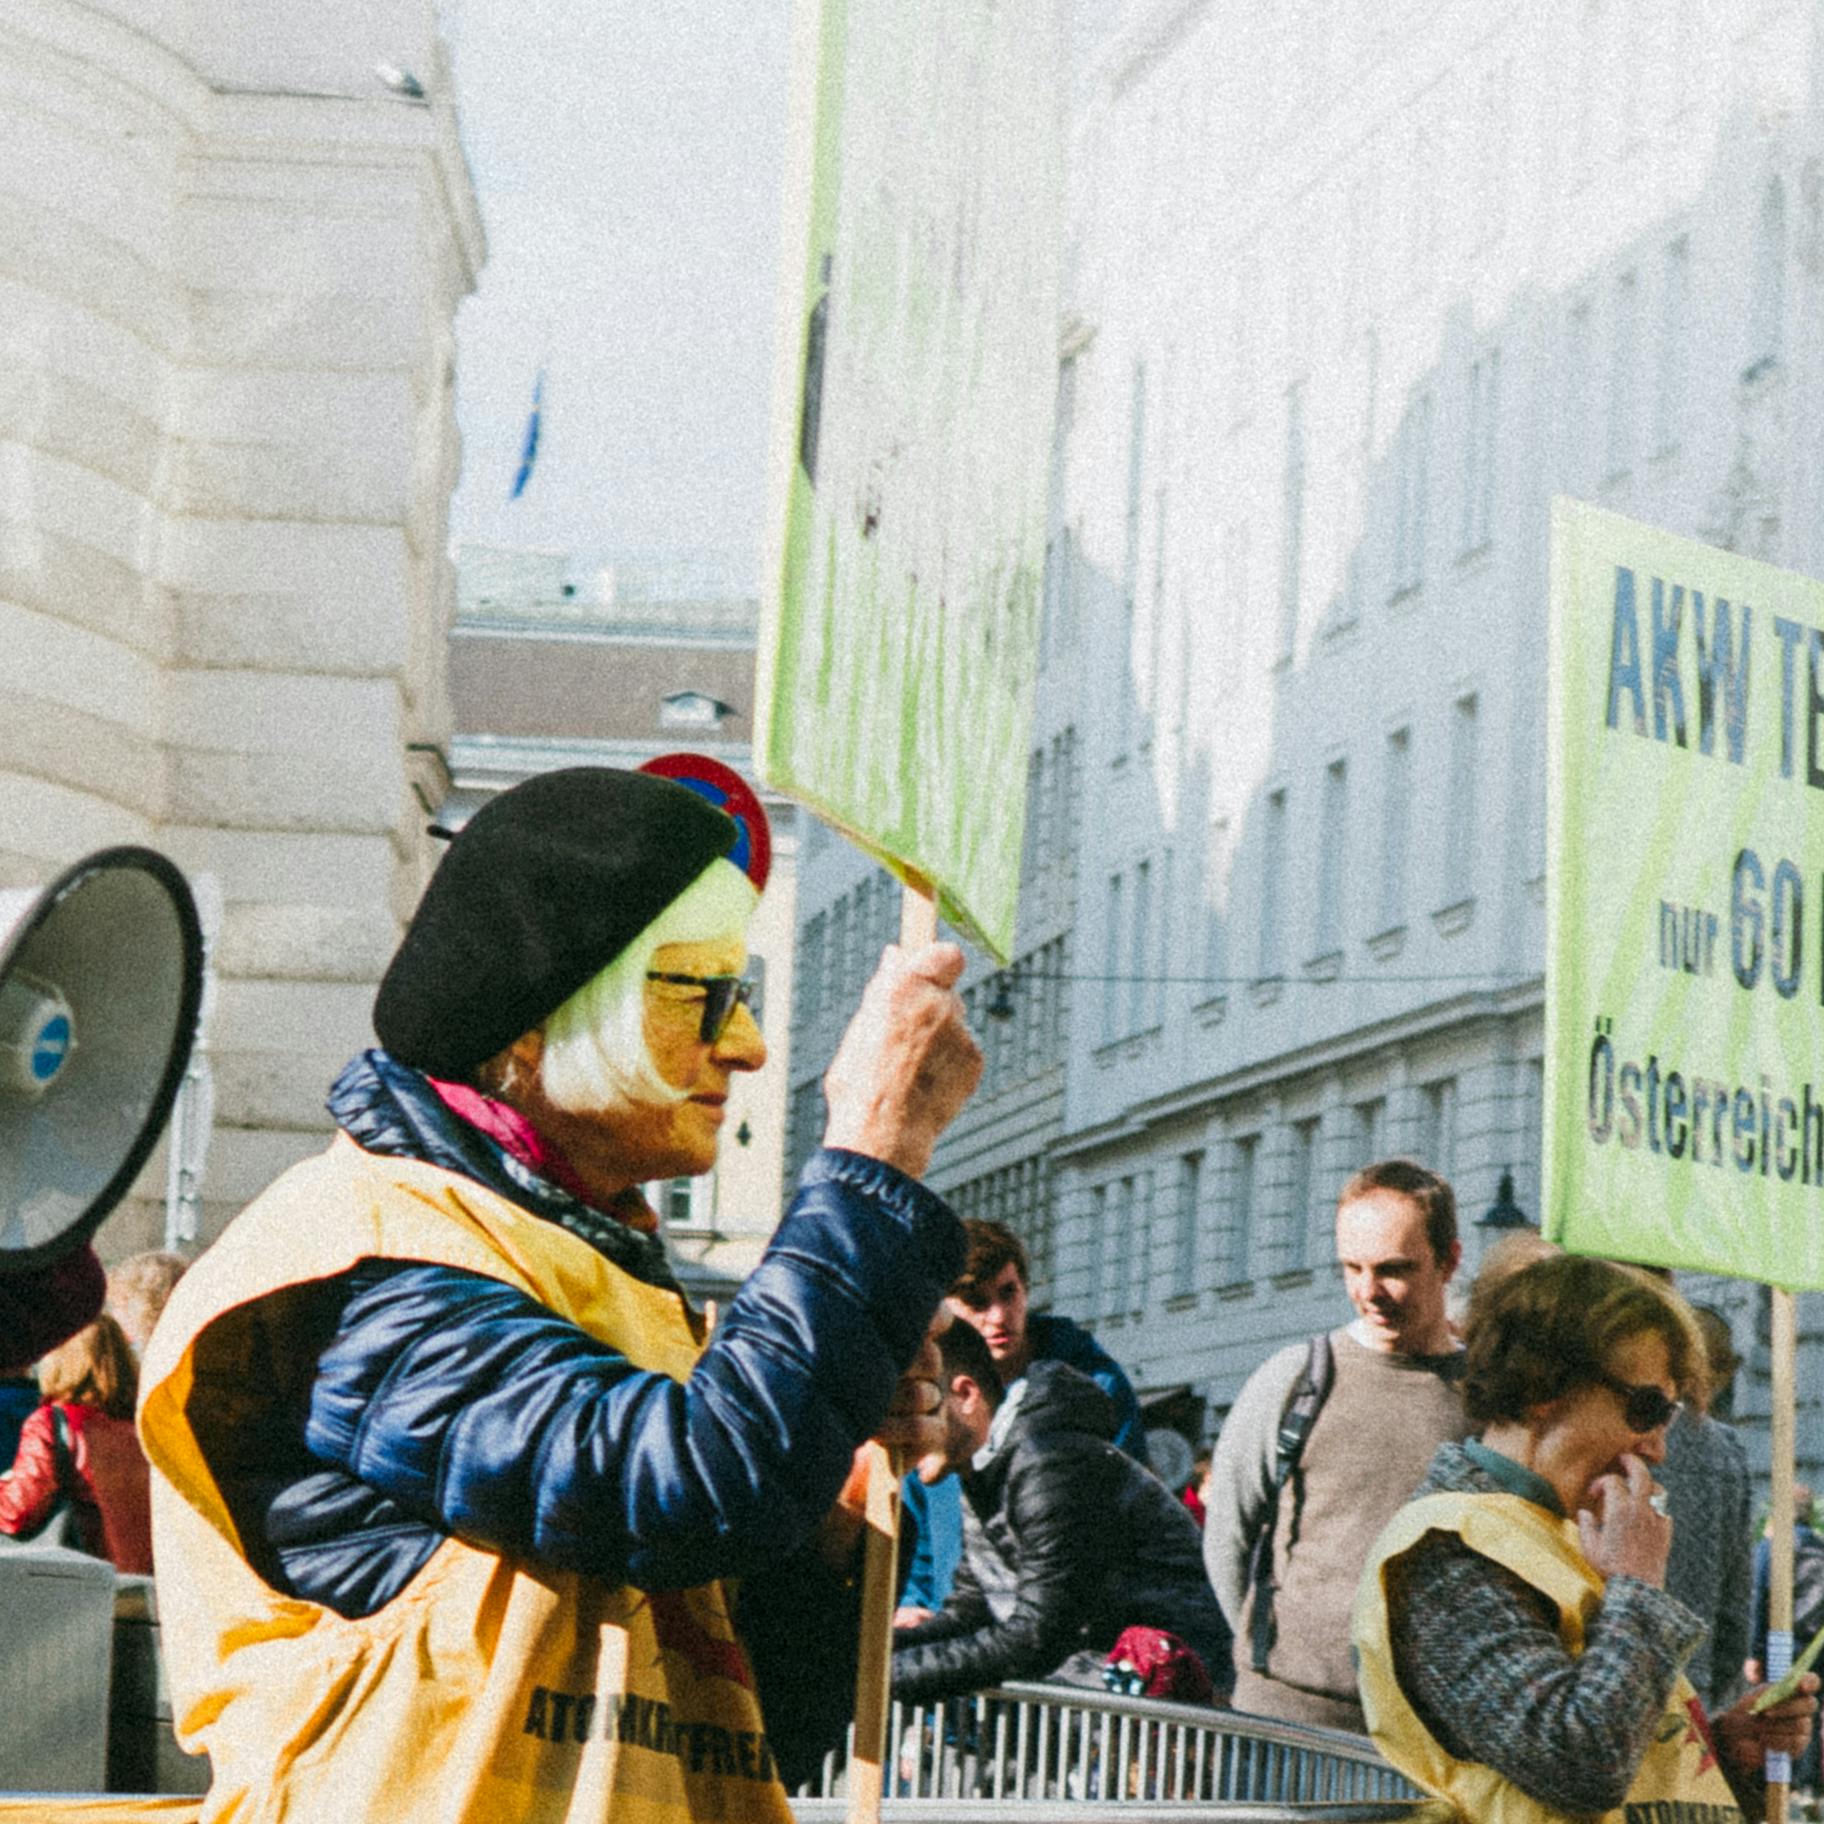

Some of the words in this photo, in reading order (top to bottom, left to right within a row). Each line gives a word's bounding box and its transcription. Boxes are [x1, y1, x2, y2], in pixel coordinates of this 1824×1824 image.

[1606, 565, 1752, 766] AKW
[1660, 900, 1718, 977] nur
[1731, 848, 1804, 999] 60
